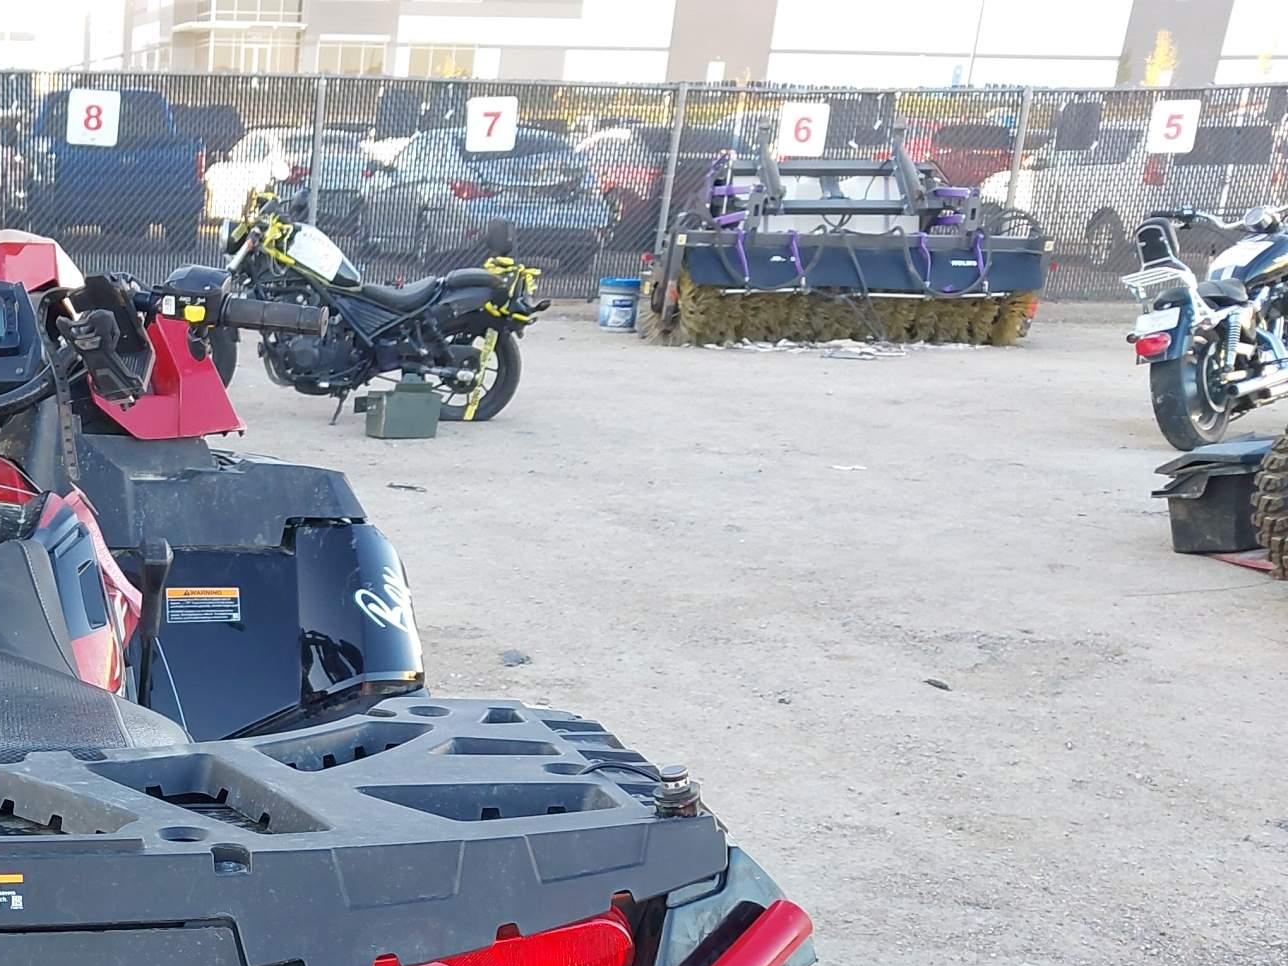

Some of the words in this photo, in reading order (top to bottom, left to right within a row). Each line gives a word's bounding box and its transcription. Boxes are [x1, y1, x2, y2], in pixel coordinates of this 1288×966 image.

[83, 104, 103, 131] 8
[482, 111, 503, 137] 7
[793, 117, 813, 143] 6
[1165, 113, 1185, 138] 5
